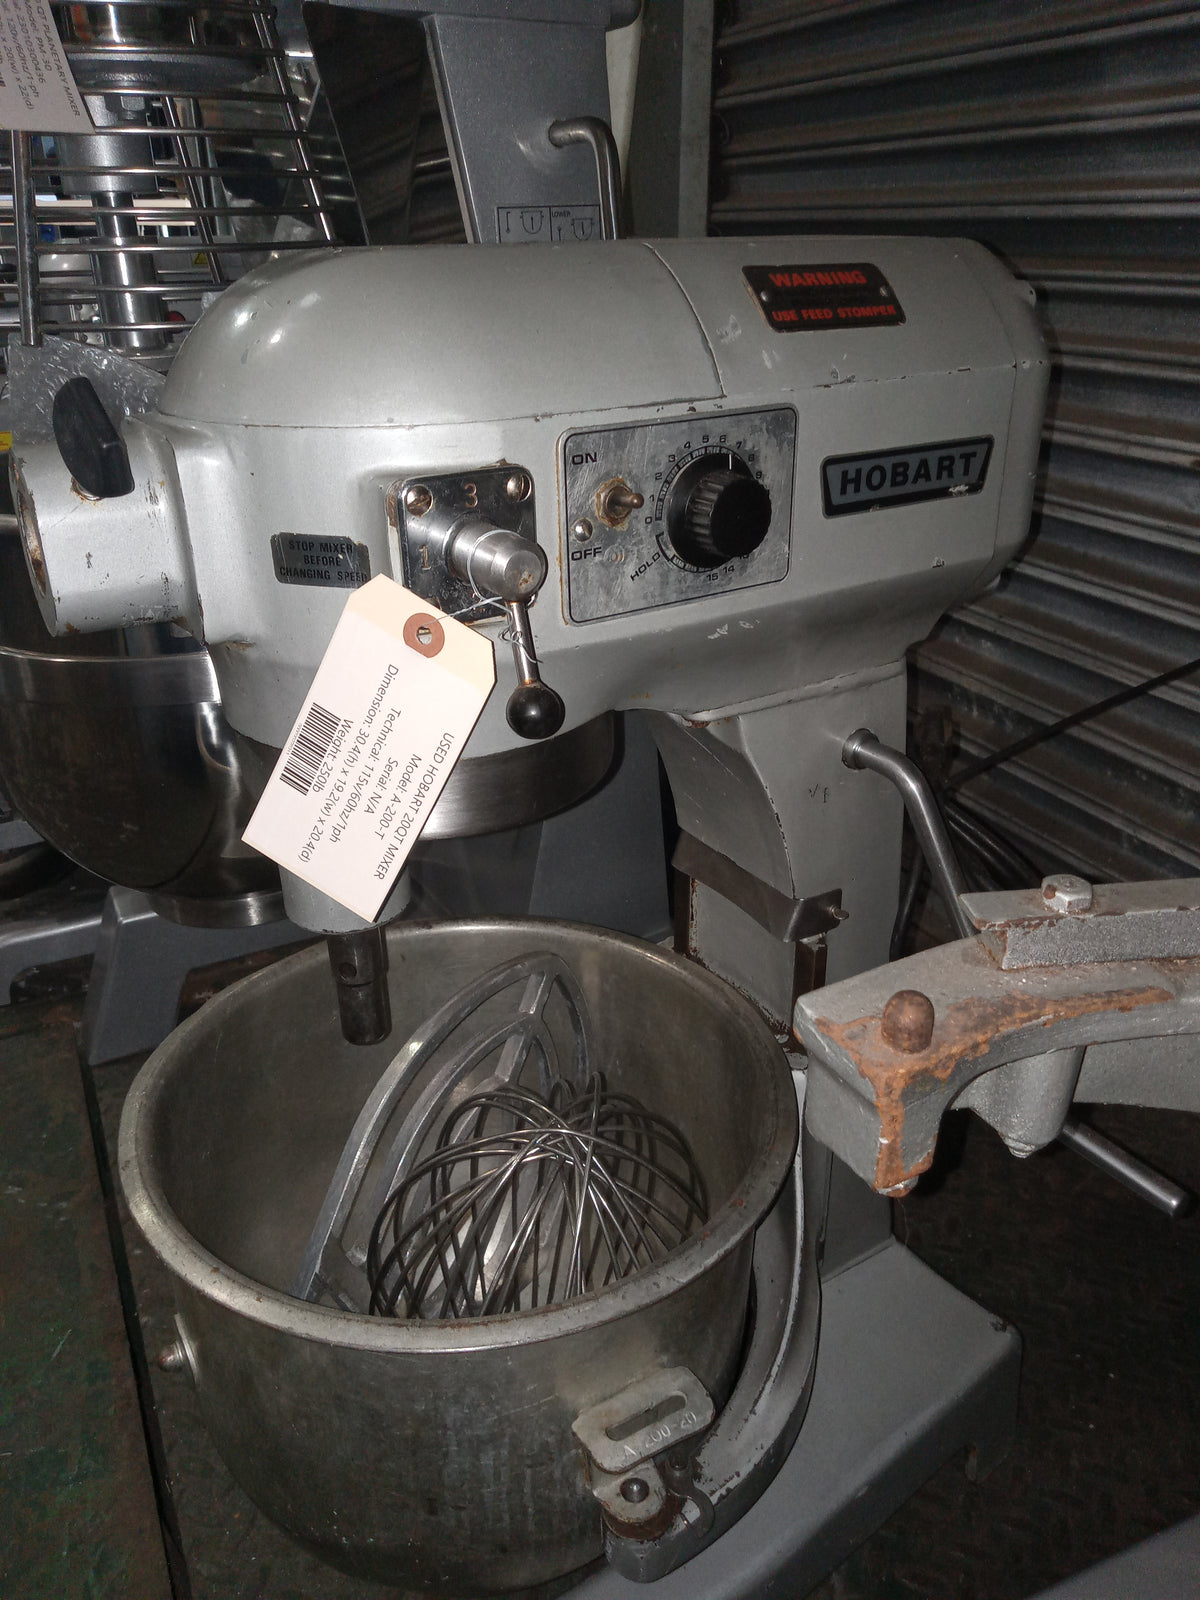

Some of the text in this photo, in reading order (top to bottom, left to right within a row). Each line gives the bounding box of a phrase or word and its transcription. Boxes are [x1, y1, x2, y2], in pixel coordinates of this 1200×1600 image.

[35, 36, 53, 71] PM-30
[43, 24, 70, 85] PLANETARY
[63, 85, 81, 117] MIXER
[769, 270, 868, 288] WARNING
[772, 304, 897, 323] USE FEED STOMPER
[683, 441, 691, 450] 4
[702, 434, 710, 443] 5
[719, 434, 727, 443] 6
[736, 441, 743, 450] 7
[571, 452, 598, 466] ON
[668, 454, 676, 463] 3
[655, 472, 663, 481] 2
[755, 471, 763, 480] 9
[839, 451, 978, 497] HOBART
[464, 483, 478, 508] 3
[645, 516, 653, 525] 0
[288, 540, 354, 554] STOP MIXER
[571, 546, 603, 561] OFF
[303, 554, 342, 567] BEFORE
[419, 545, 432, 571] 1
[630, 552, 662, 581] HOLD
[723, 565, 736, 574] 14
[279, 567, 370, 583] CHANGING SPEED
[706, 572, 720, 582] 15
[297, 663, 399, 863] Dimension: 30.4(h) x 19.2(w) x 20.4(d)
[312, 718, 354, 793] Weight: 250lb
[329, 708, 402, 843] Technical: 115v/60hz/1ph
[363, 756, 399, 814] Serial: N/A
[374, 753, 423, 841] Model: A-200-T
[373, 732, 455, 880] USED HOBART 20QT MIXER
